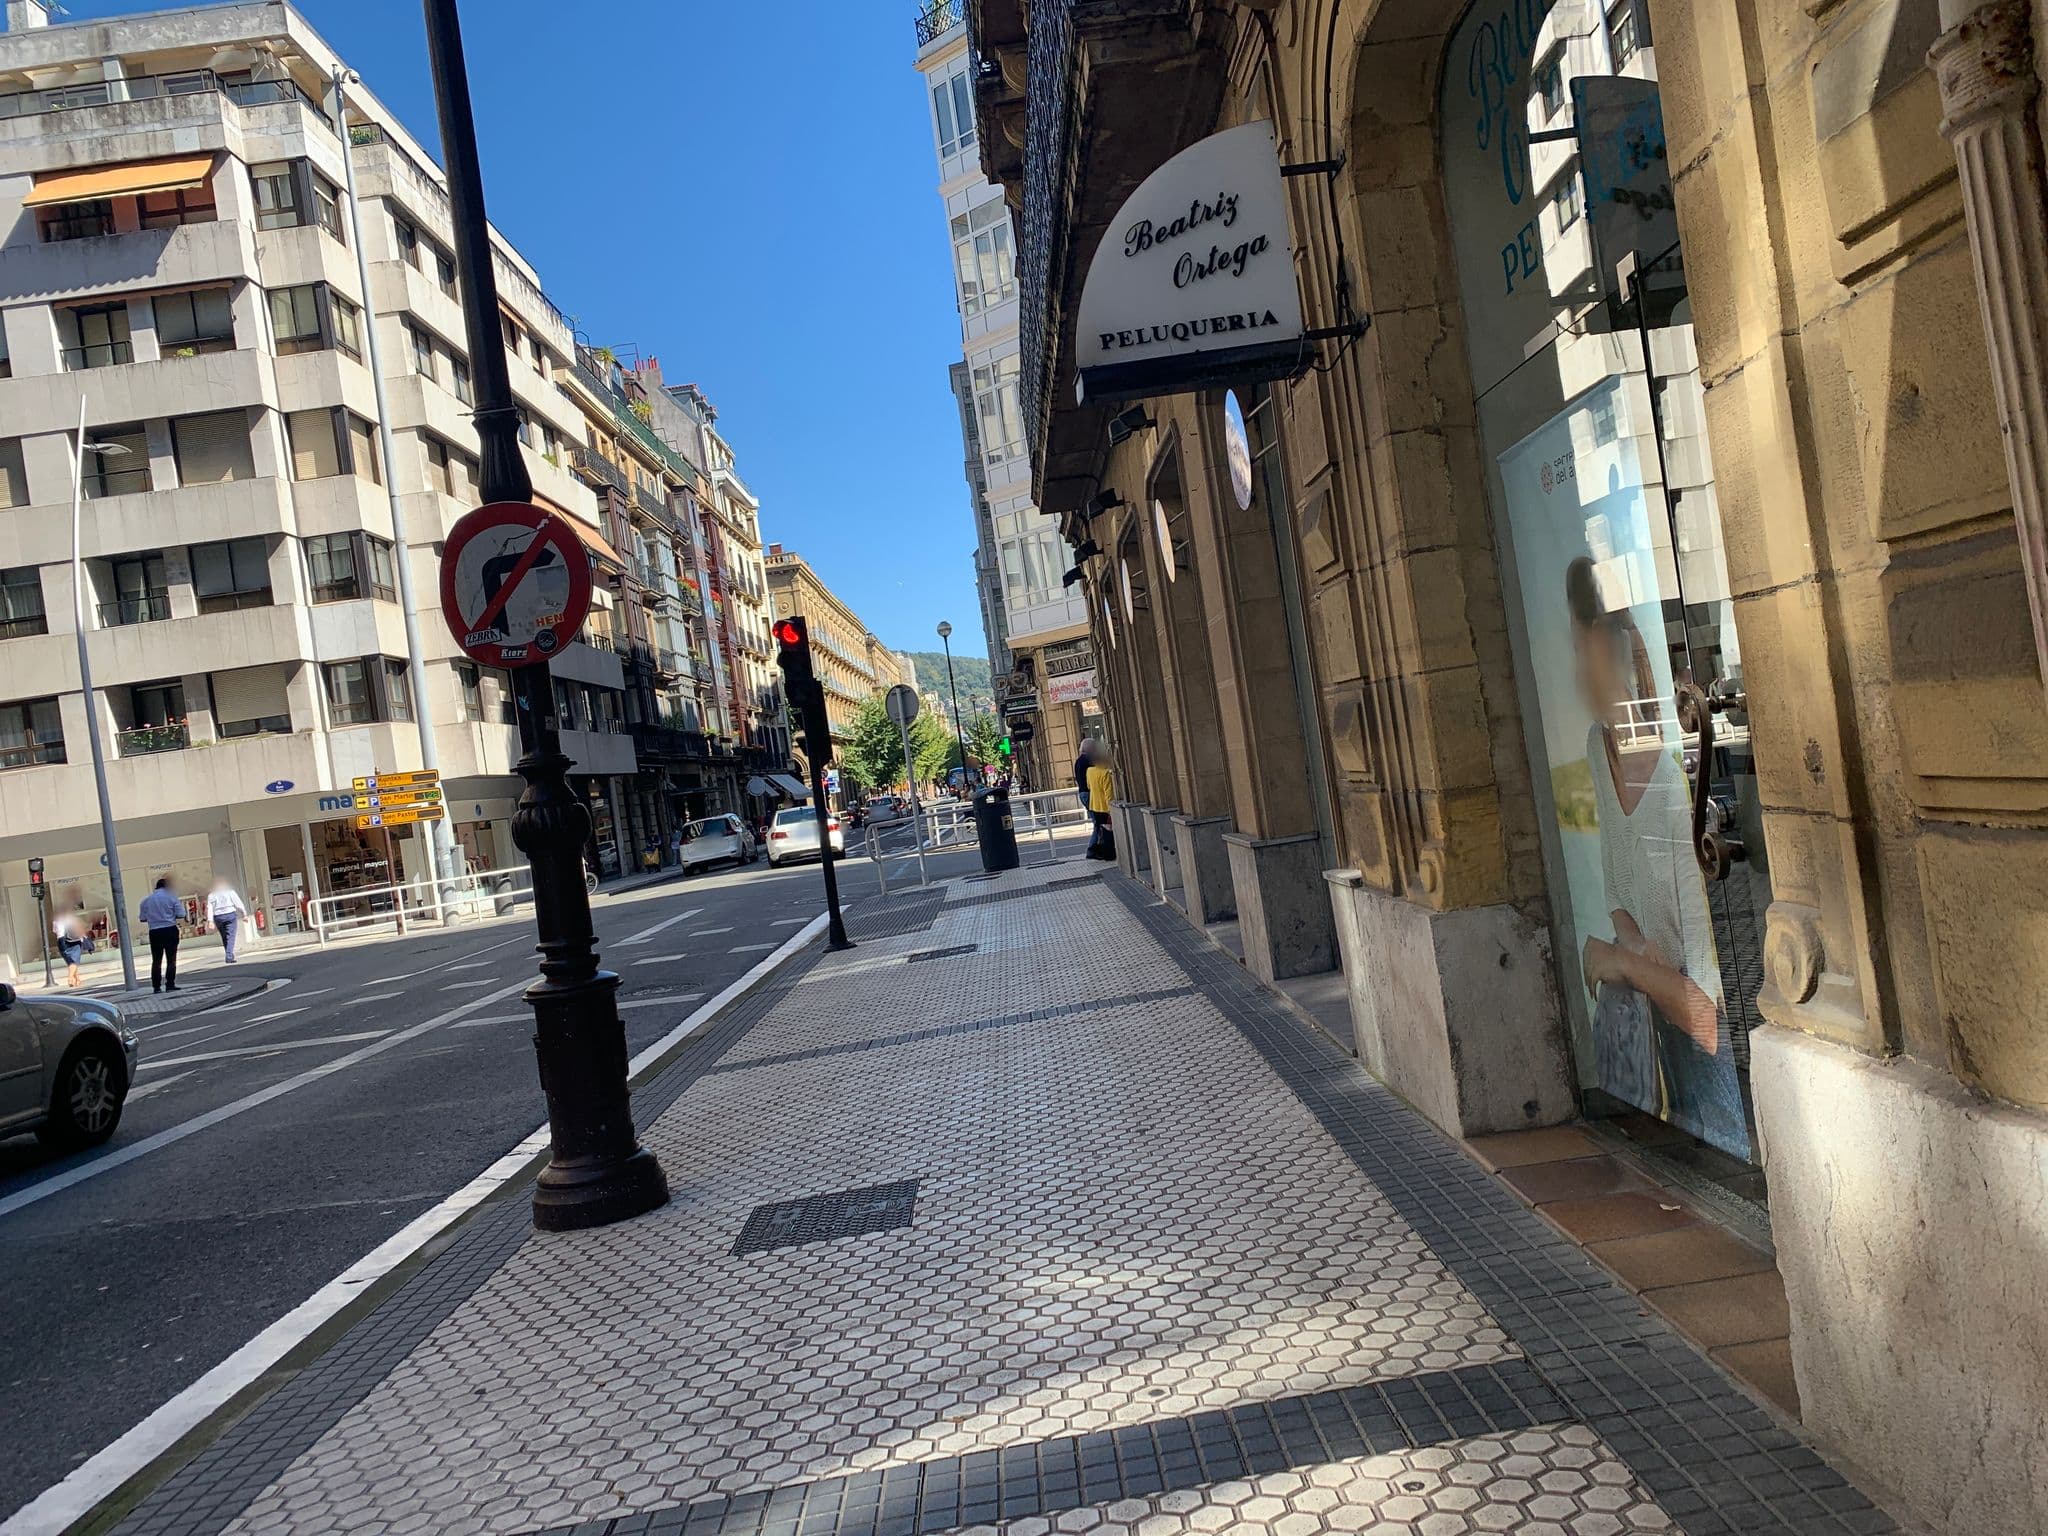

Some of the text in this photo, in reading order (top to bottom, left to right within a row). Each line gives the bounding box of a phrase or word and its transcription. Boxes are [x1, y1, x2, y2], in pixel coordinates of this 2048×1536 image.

[1124, 191, 1239, 258] Beatriz
[1173, 234, 1269, 288] Ortega
[1099, 309, 1279, 350] PELUQUERIA
